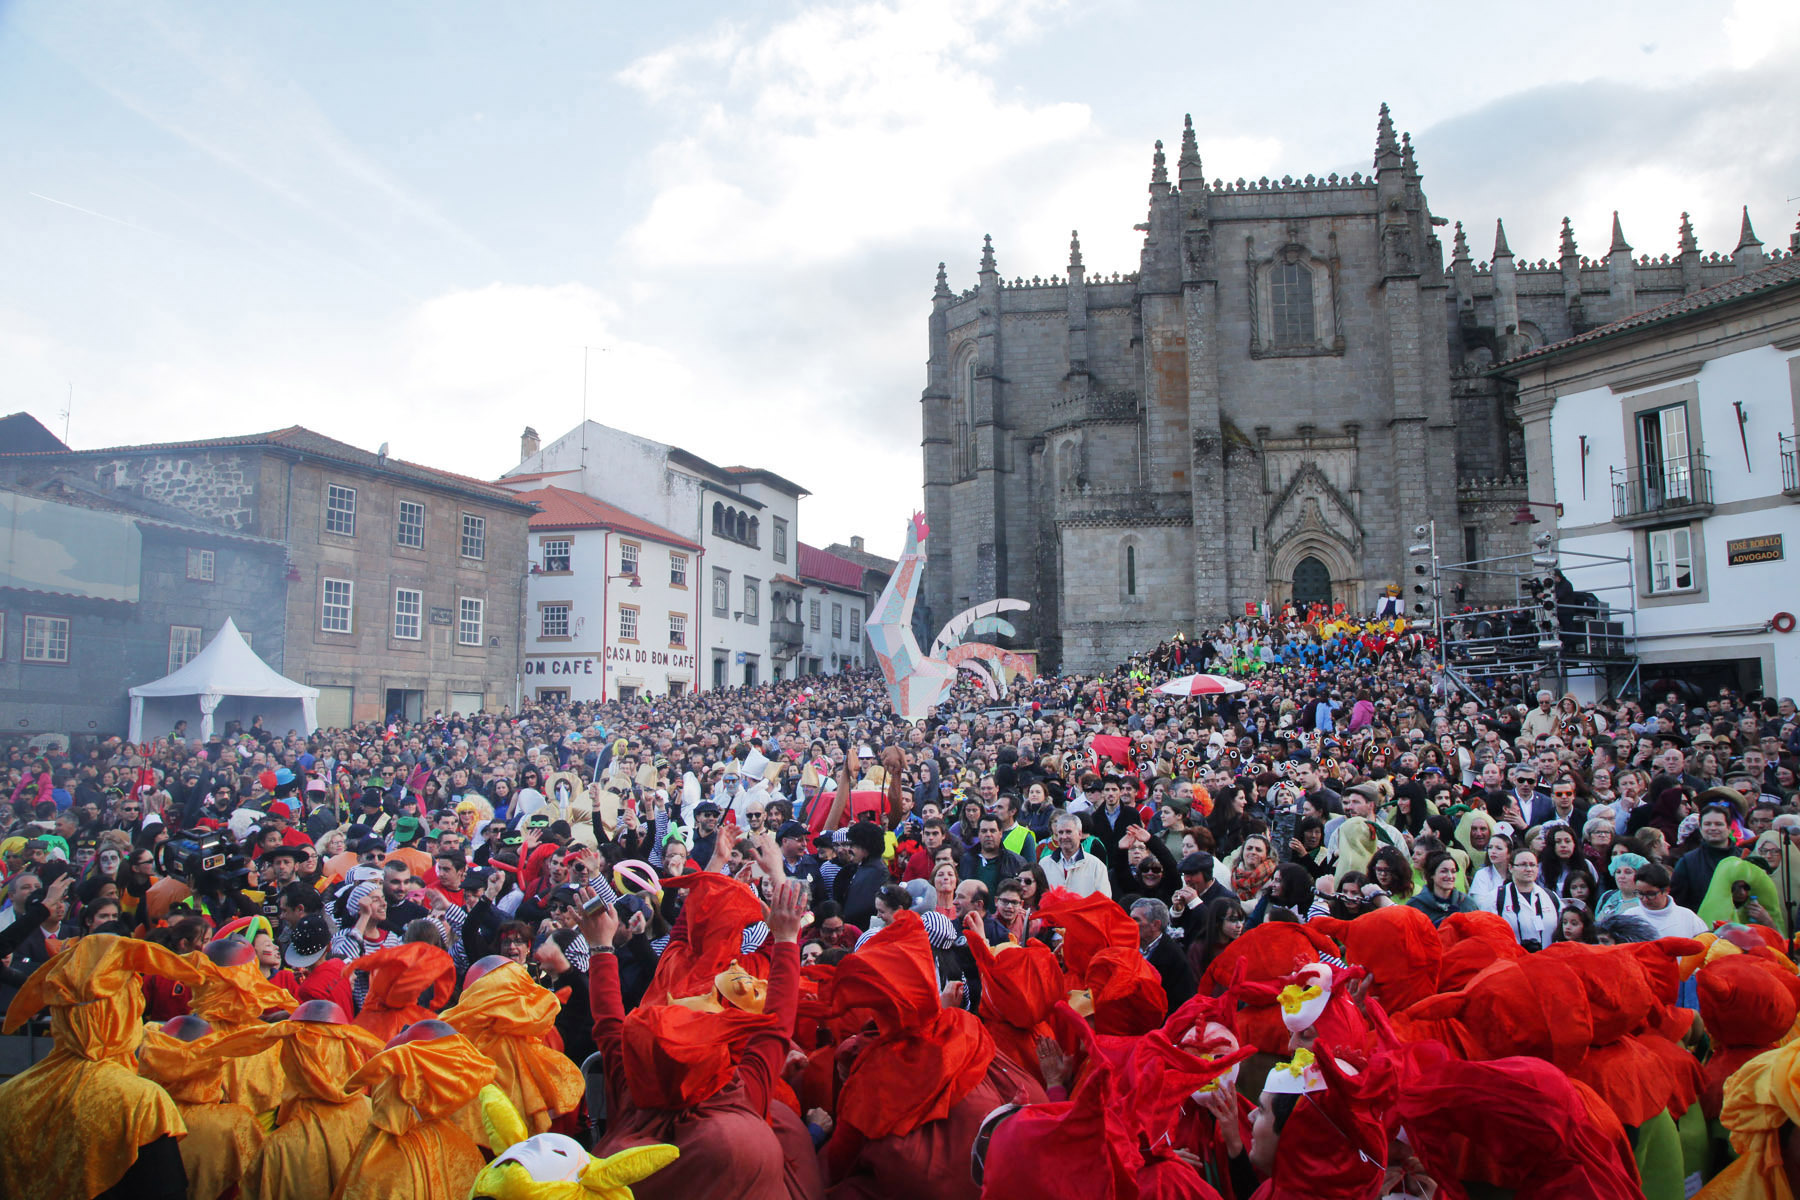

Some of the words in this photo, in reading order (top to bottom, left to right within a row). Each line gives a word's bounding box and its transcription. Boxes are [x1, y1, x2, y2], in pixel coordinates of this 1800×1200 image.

[1729, 540, 1747, 552] JOSÉ
[1733, 550, 1780, 563] ADVOGADO
[606, 646, 631, 662] CASA
[635, 649, 647, 663] DO
[652, 651, 668, 666] BOM
[673, 654, 694, 669] CAFÉ
[552, 658, 593, 675] CAFÉ
